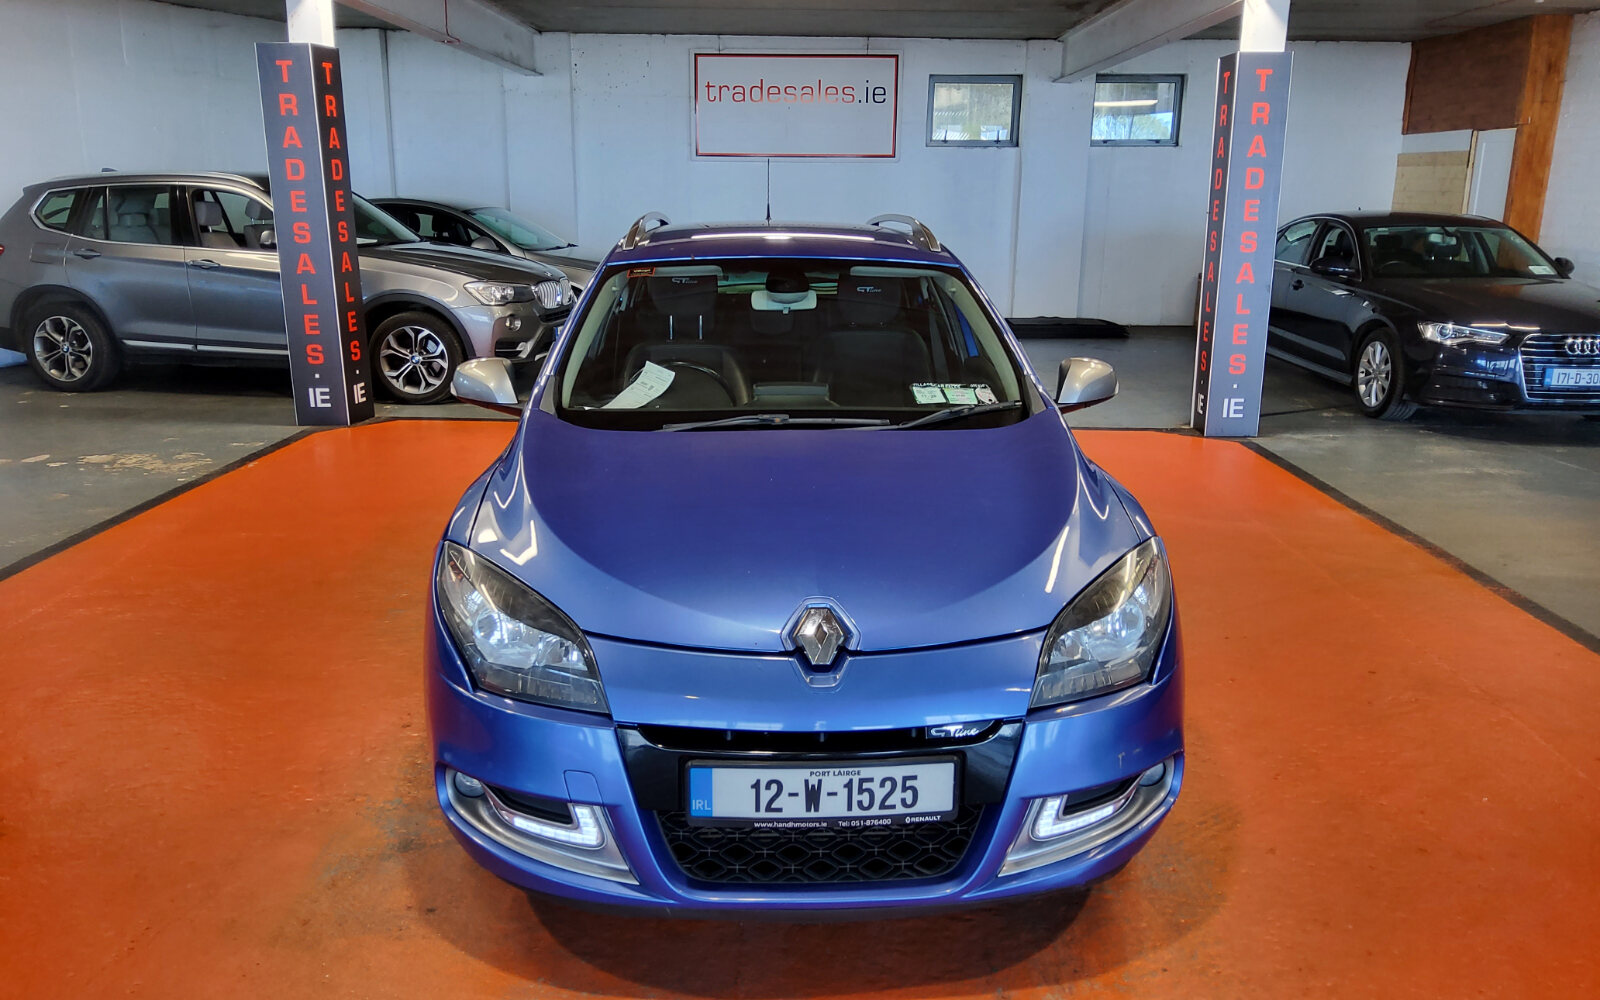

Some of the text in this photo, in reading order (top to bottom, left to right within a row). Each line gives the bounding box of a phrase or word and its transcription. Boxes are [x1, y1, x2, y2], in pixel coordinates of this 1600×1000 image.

[704, 78, 887, 104] tradesales.ie
[1556, 372, 1600, 385] 171-D-30
[750, 775, 919, 813] 12-W-1525
[692, 799, 712, 811] IRL
[850, 818, 892, 827] 051-876400
[910, 815, 942, 823] RENAULT
